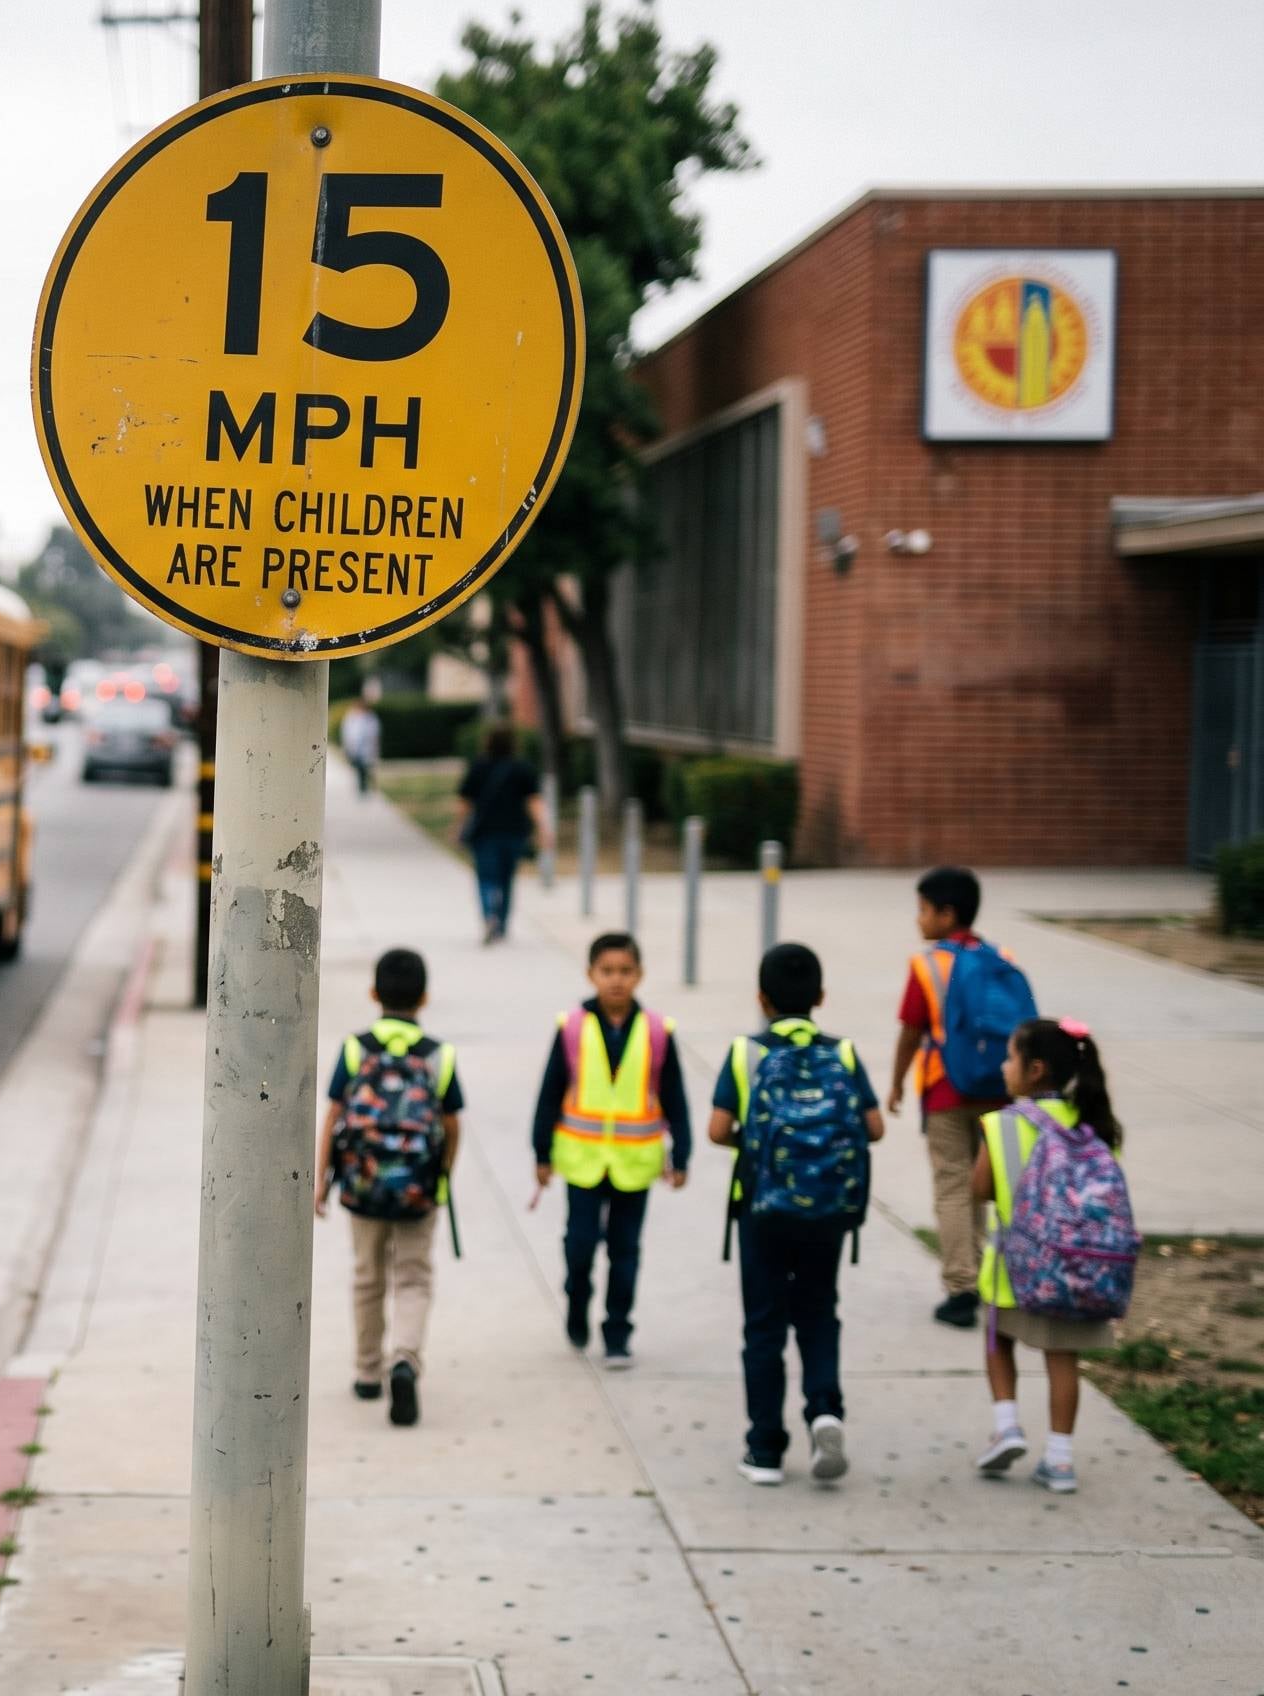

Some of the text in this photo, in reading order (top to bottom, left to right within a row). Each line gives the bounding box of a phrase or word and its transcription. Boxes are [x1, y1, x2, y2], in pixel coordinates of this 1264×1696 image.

[206, 172, 451, 362] 15
[205, 390, 422, 470] MPH
[144, 484, 464, 540] WHEN CHILDREN
[166, 543, 434, 597] ARE PRESENT
